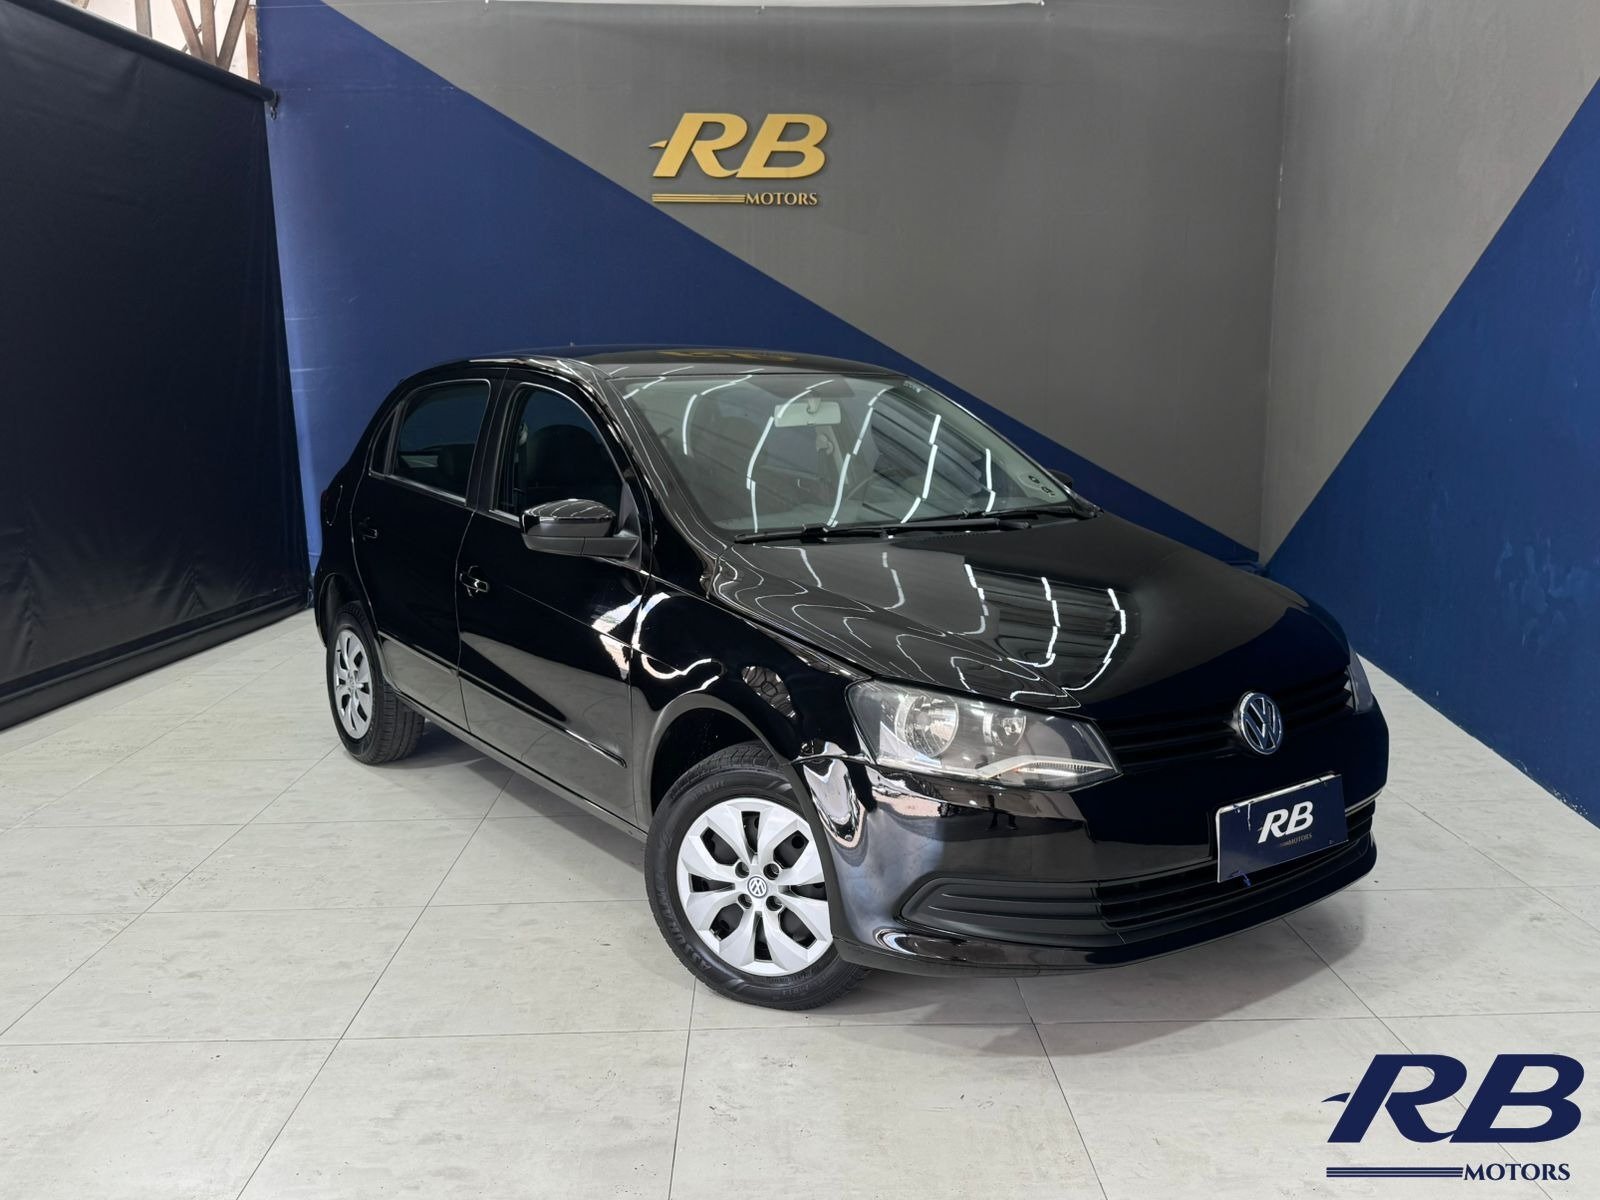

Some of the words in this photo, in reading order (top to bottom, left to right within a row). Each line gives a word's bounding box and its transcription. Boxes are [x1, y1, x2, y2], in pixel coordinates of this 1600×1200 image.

[649, 112, 828, 178] RB
[745, 192, 818, 206] MOTORS
[1240, 692, 1281, 754] VW
[1257, 800, 1314, 844] RB
[1288, 833, 1313, 846] MOTORS
